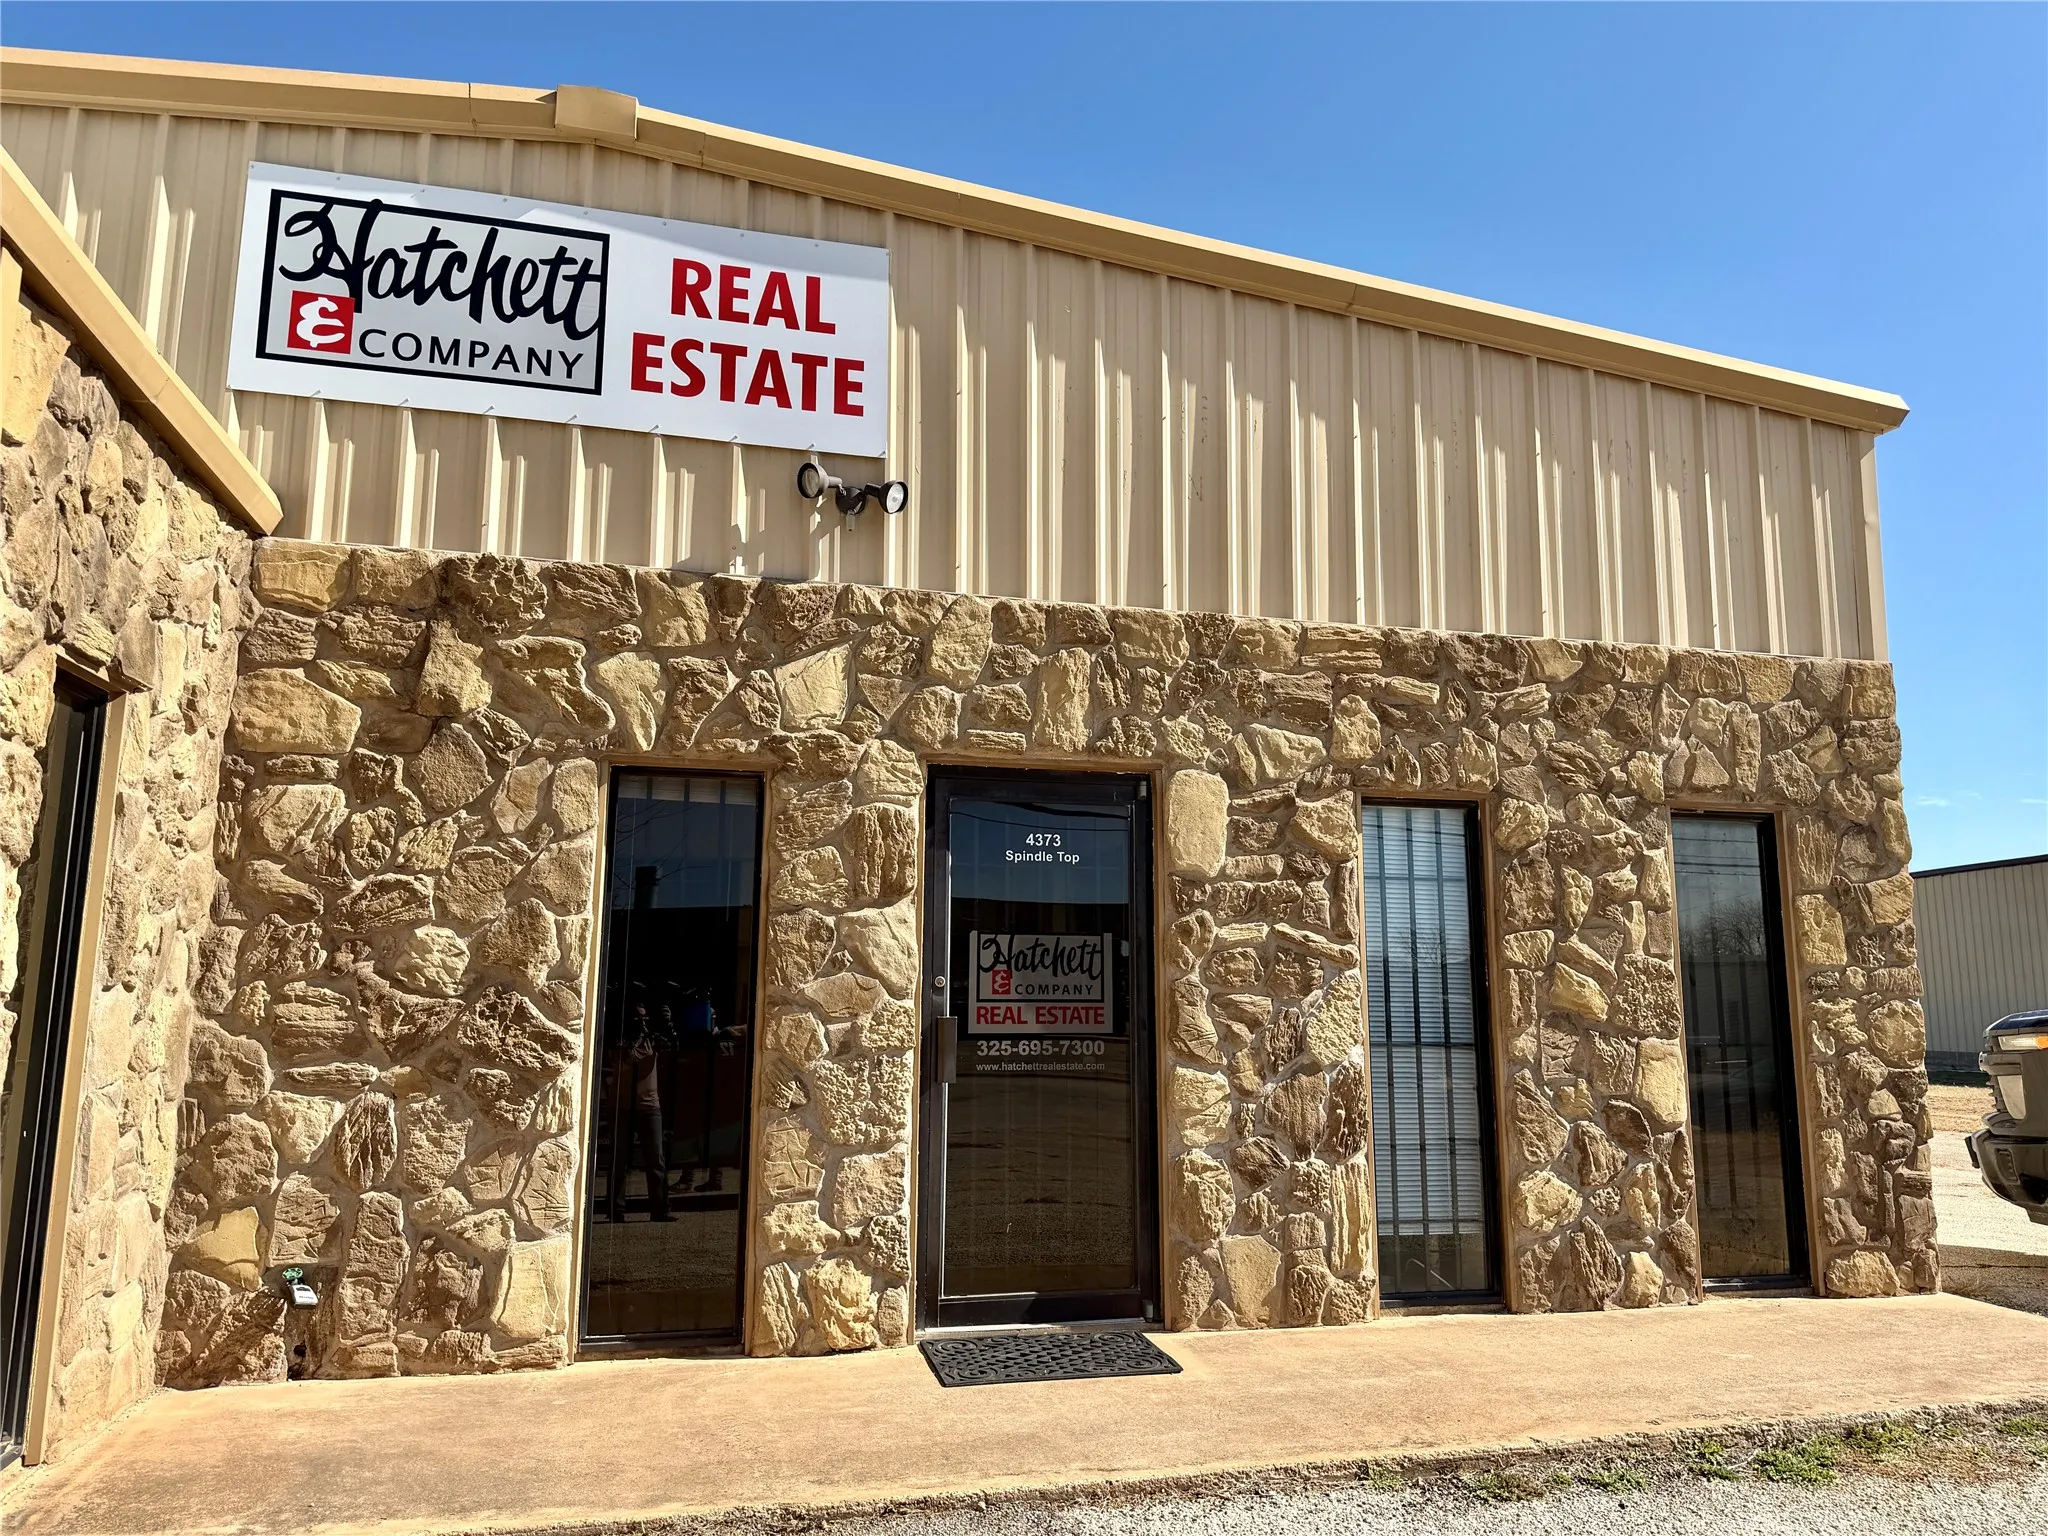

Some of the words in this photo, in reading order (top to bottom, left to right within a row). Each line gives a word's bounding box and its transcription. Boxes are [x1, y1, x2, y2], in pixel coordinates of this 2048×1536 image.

[278, 199, 601, 341] Hatchett
[670, 258, 836, 335] REAL
[359, 328, 583, 380] COMPANY
[630, 332, 865, 417] ESTATE
[1025, 833, 1062, 847] 4373
[1005, 850, 1053, 863] Spindle
[1058, 851, 1080, 864] Top
[979, 934, 1101, 981] Hatchett
[1014, 983, 1094, 996] COMPANY
[975, 1006, 1028, 1025] REAL
[1035, 1006, 1105, 1025] ESTATE
[976, 1040, 1105, 1056] 325-695-7300
[976, 1061, 1105, 1072] www.hatchettrealestate.com
